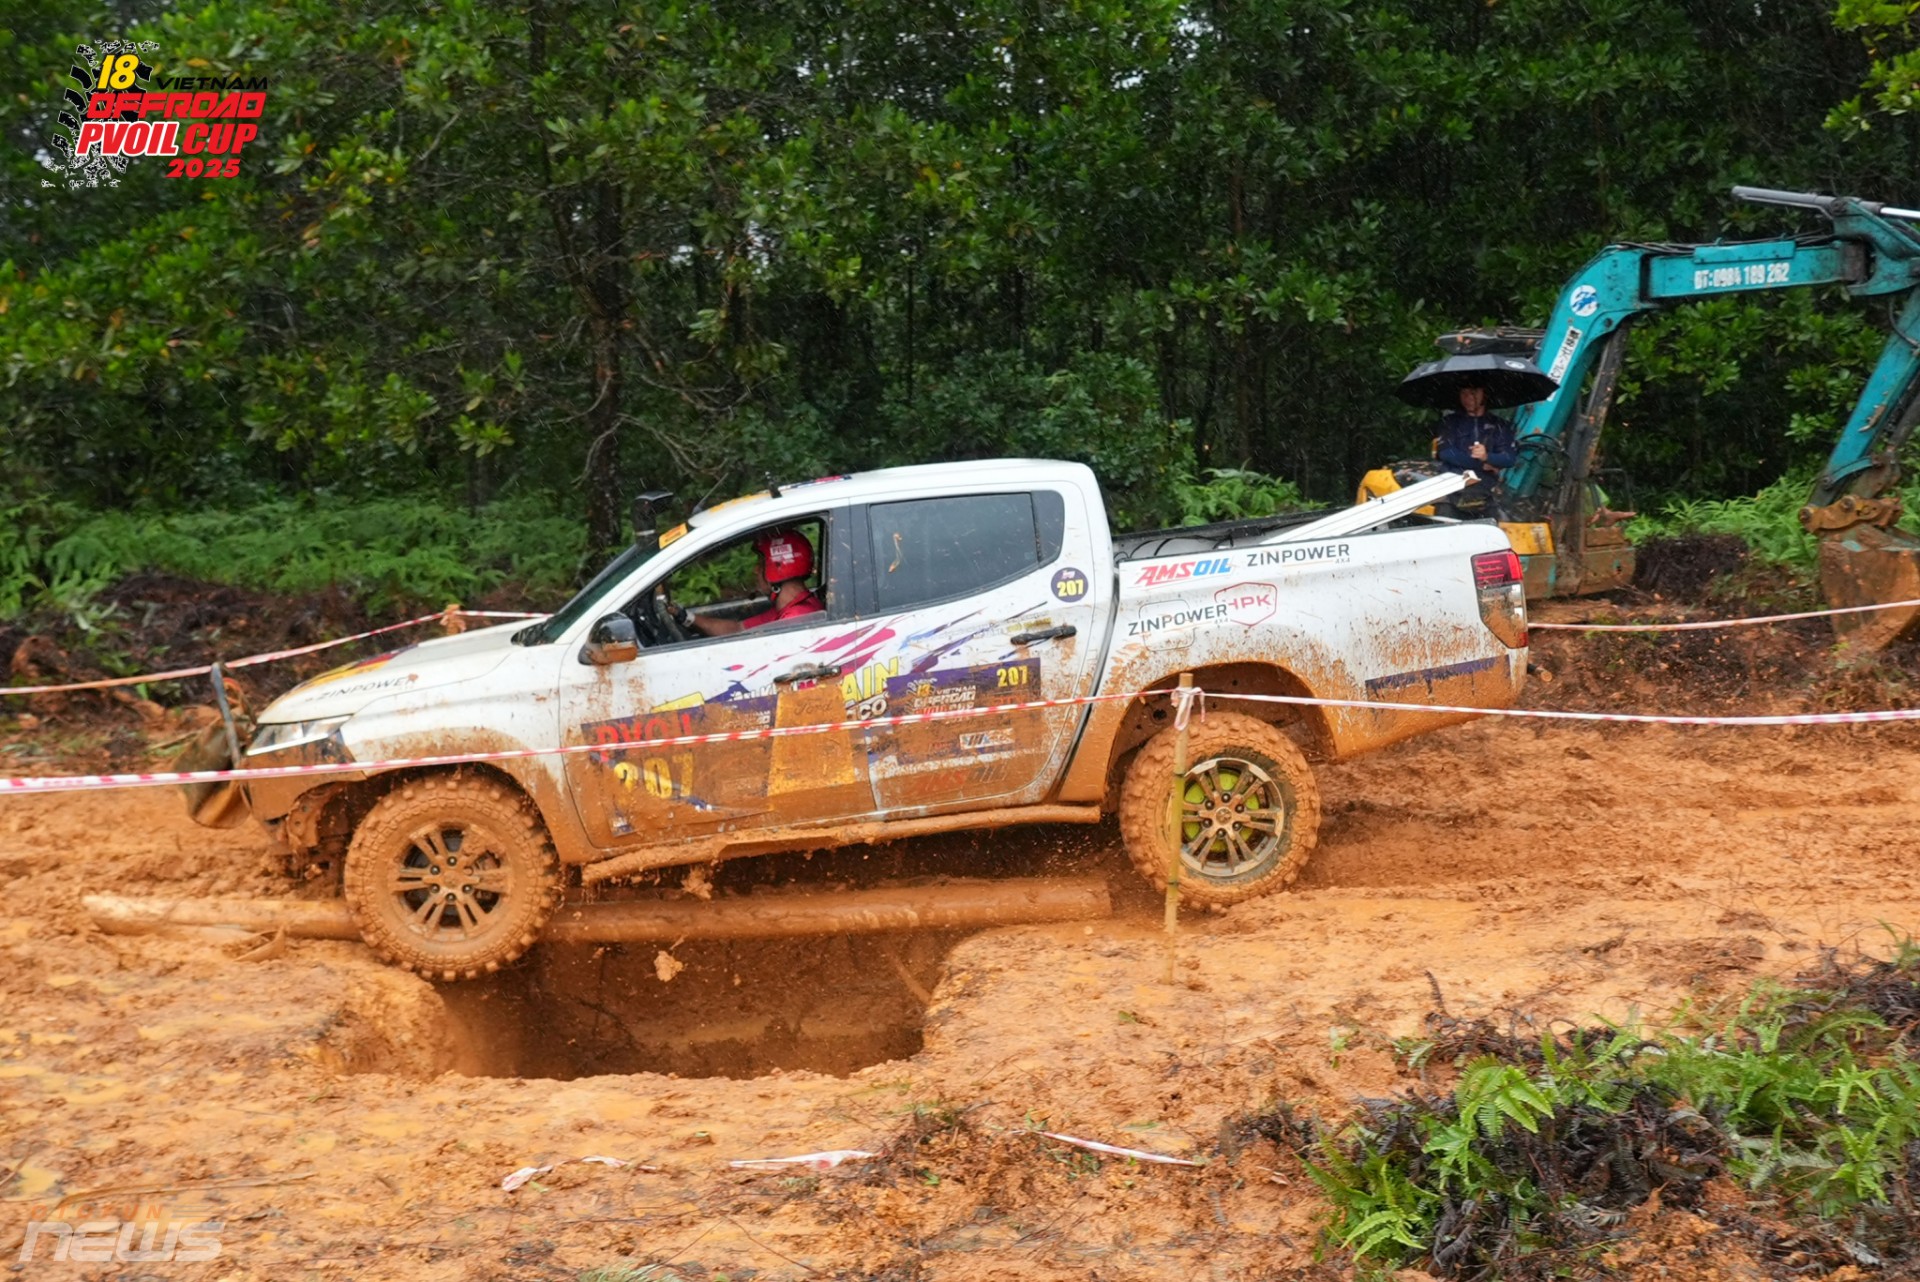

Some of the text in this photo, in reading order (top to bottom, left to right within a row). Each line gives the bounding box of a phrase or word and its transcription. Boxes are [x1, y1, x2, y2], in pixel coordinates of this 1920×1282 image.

[1134, 544, 1350, 586] AMSOIL ZINPOWER
[1056, 579, 1084, 597] 207
[1128, 604, 1227, 636] ZINPOWER
